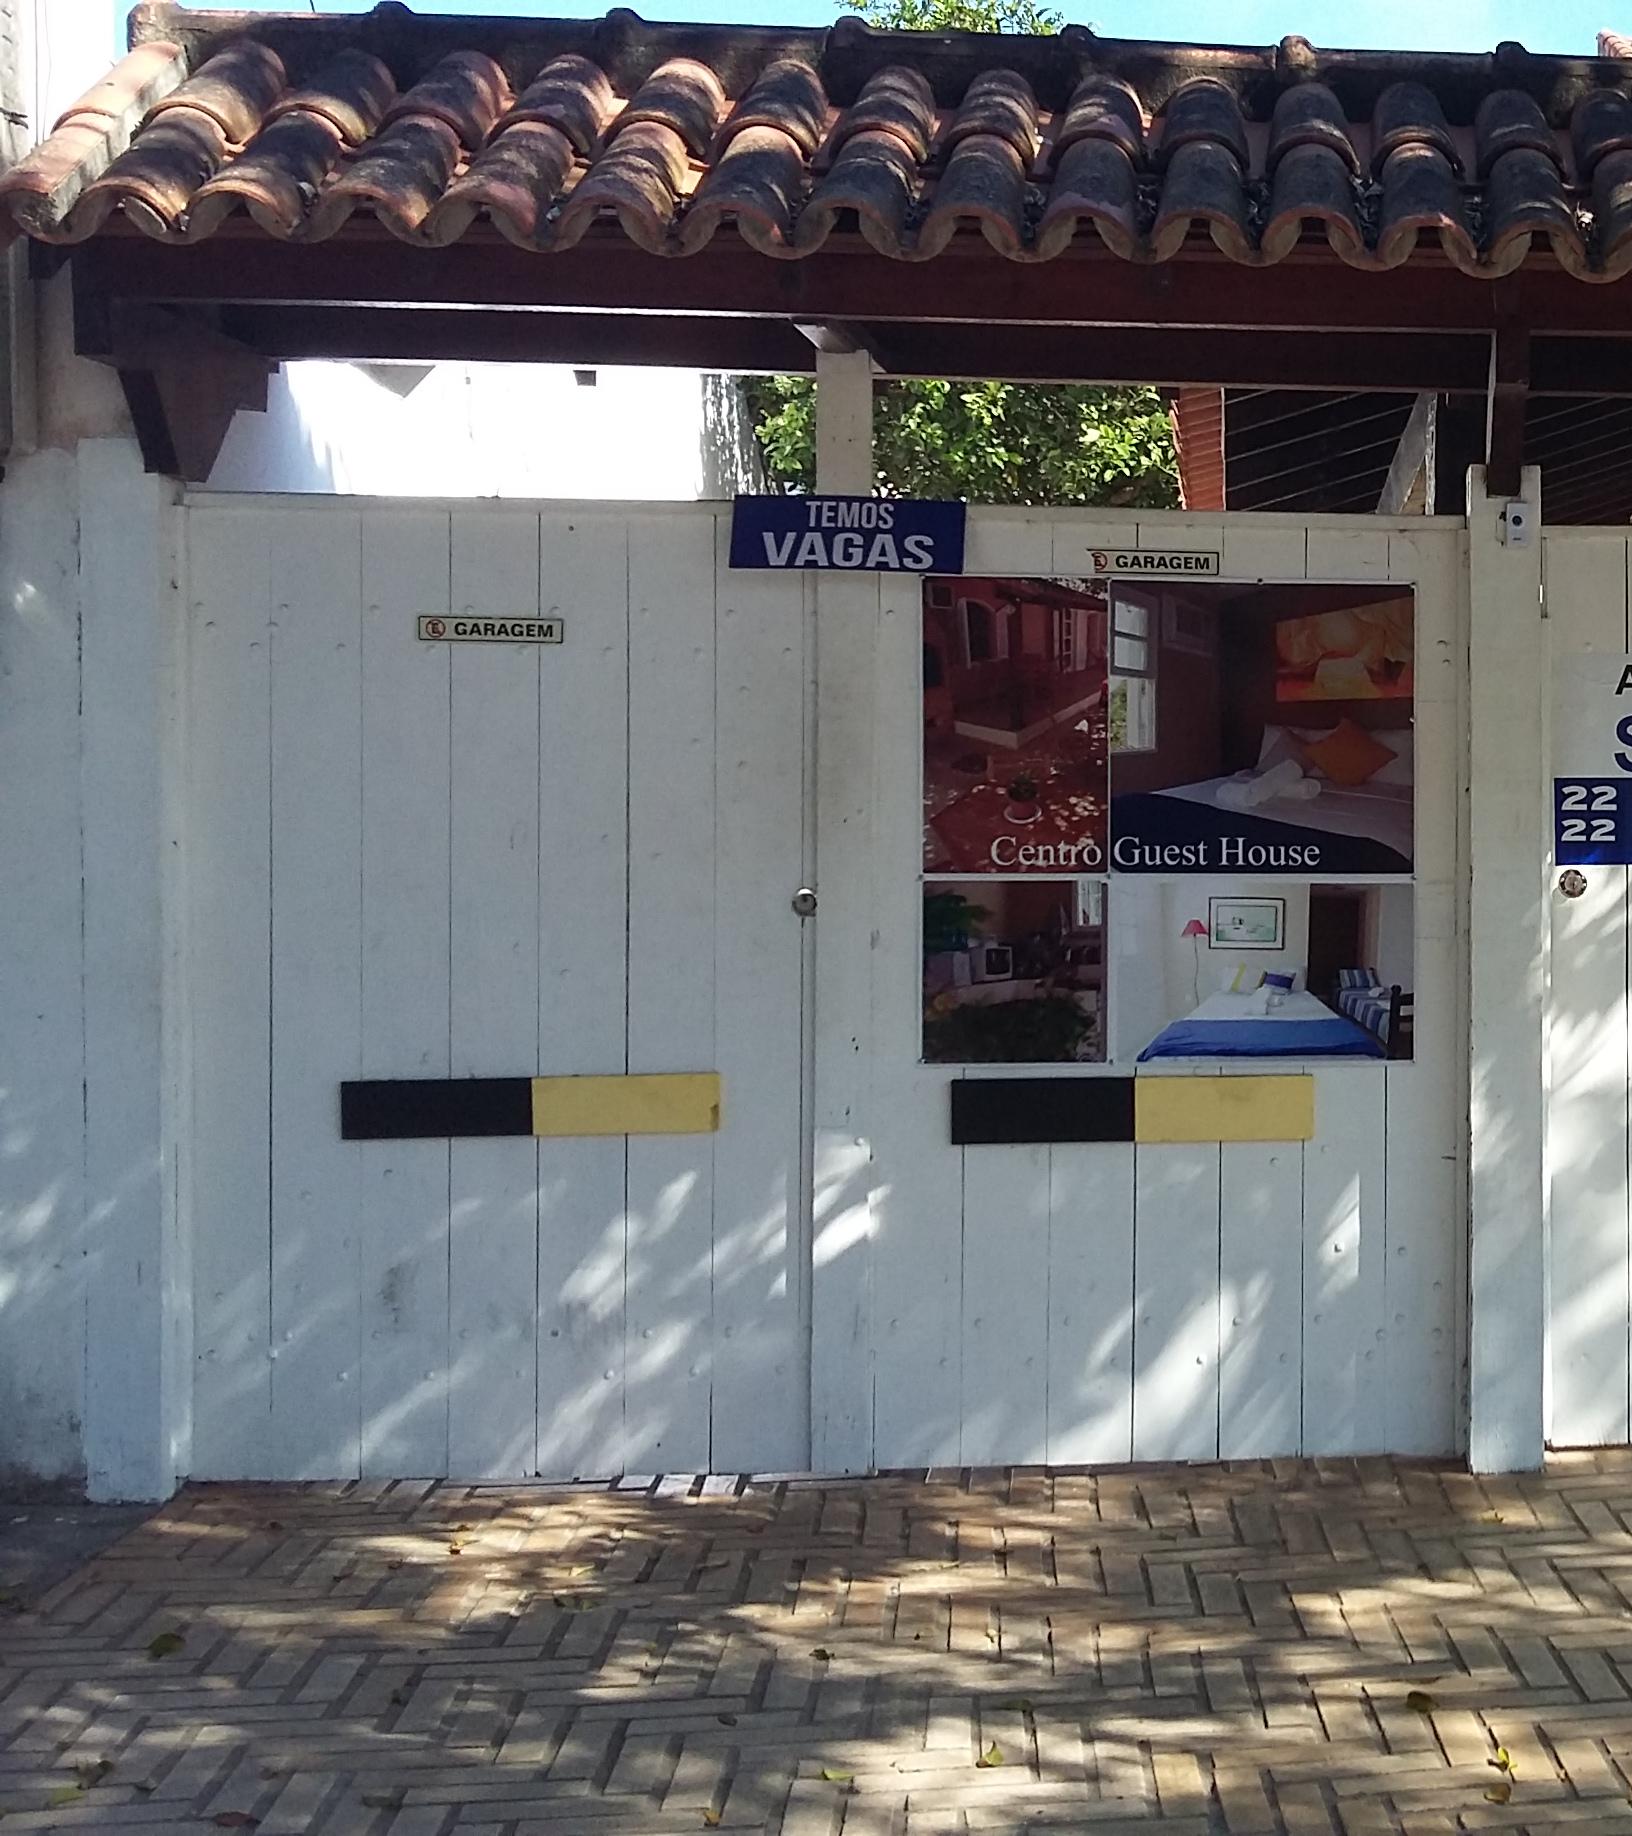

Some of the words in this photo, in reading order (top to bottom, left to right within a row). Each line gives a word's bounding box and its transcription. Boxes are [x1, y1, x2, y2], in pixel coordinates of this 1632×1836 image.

[805, 500, 895, 530] TEMOS
[761, 531, 935, 570] VAGAS
[1115, 554, 1210, 570] GARAGEM
[454, 622, 553, 638] GARAGEM
[1560, 785, 1618, 812] 22
[1560, 818, 1617, 843] 22
[990, 836, 1102, 866] Centro
[1113, 836, 1208, 866] Guest
[1218, 837, 1321, 866] House
